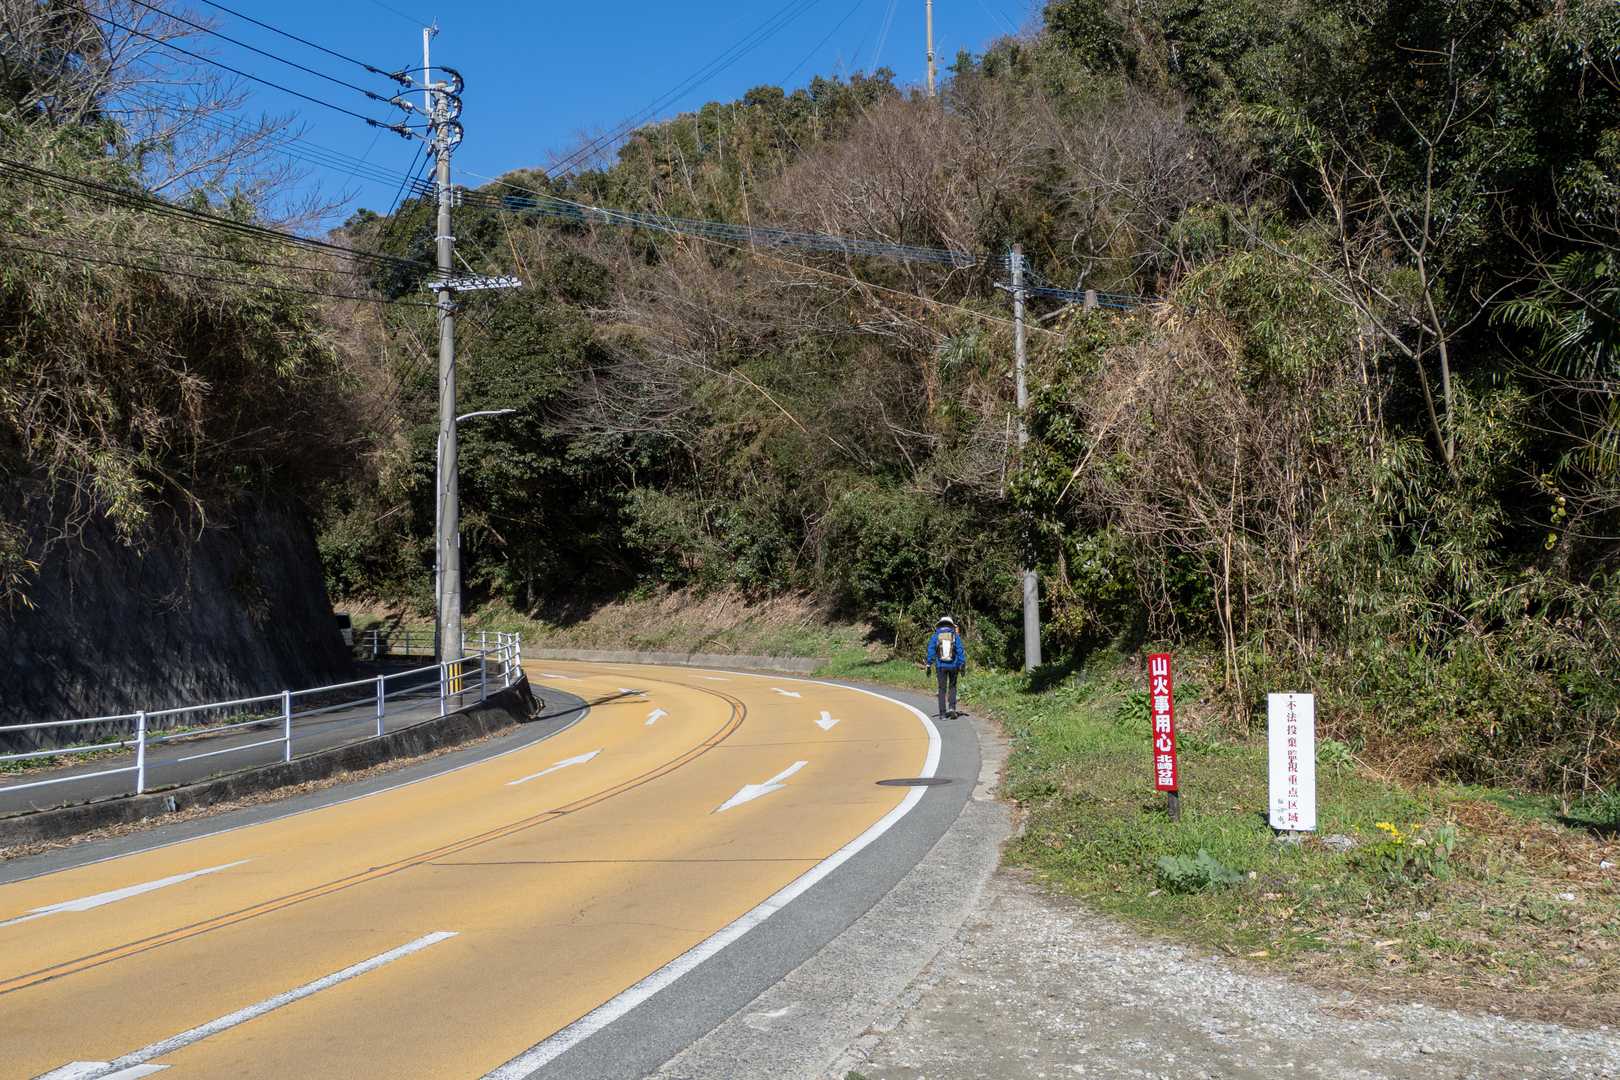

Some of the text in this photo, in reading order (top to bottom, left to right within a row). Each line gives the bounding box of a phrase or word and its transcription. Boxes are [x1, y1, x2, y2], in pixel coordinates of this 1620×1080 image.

[1152, 657, 1172, 752] 山火事用心
[1286, 700, 1298, 823] 不法投棄監視重点区域
